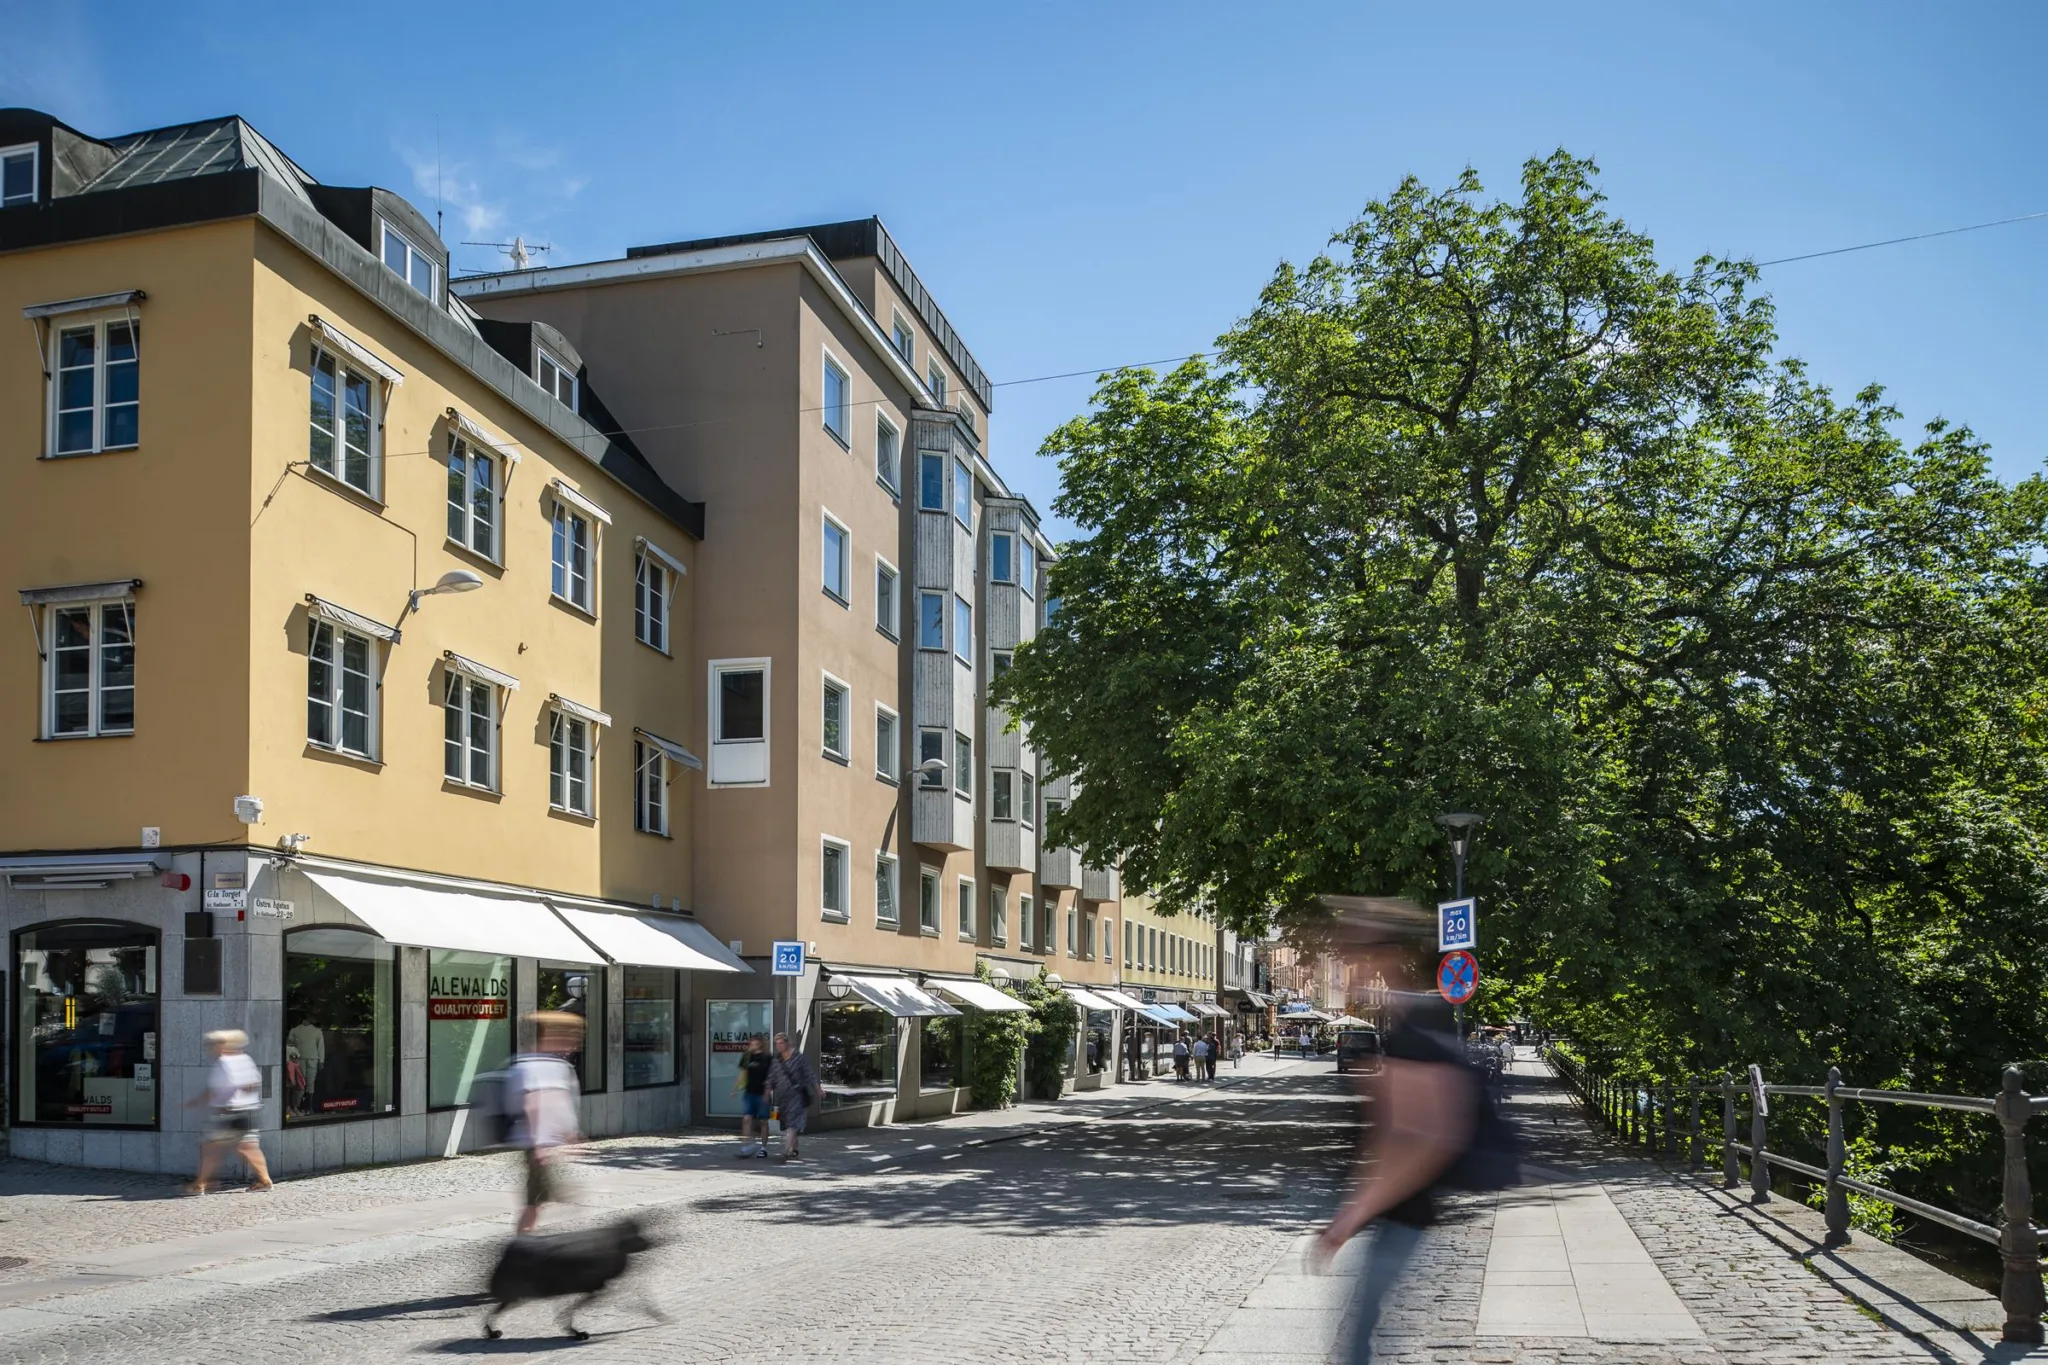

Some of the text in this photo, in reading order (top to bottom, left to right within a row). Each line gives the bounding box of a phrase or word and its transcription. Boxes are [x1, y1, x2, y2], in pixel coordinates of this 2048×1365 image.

[222, 890, 241, 900] Torget
[1446, 917, 1466, 933] 20
[780, 953, 797, 963] 20
[430, 976, 508, 996] ALEWALDS
